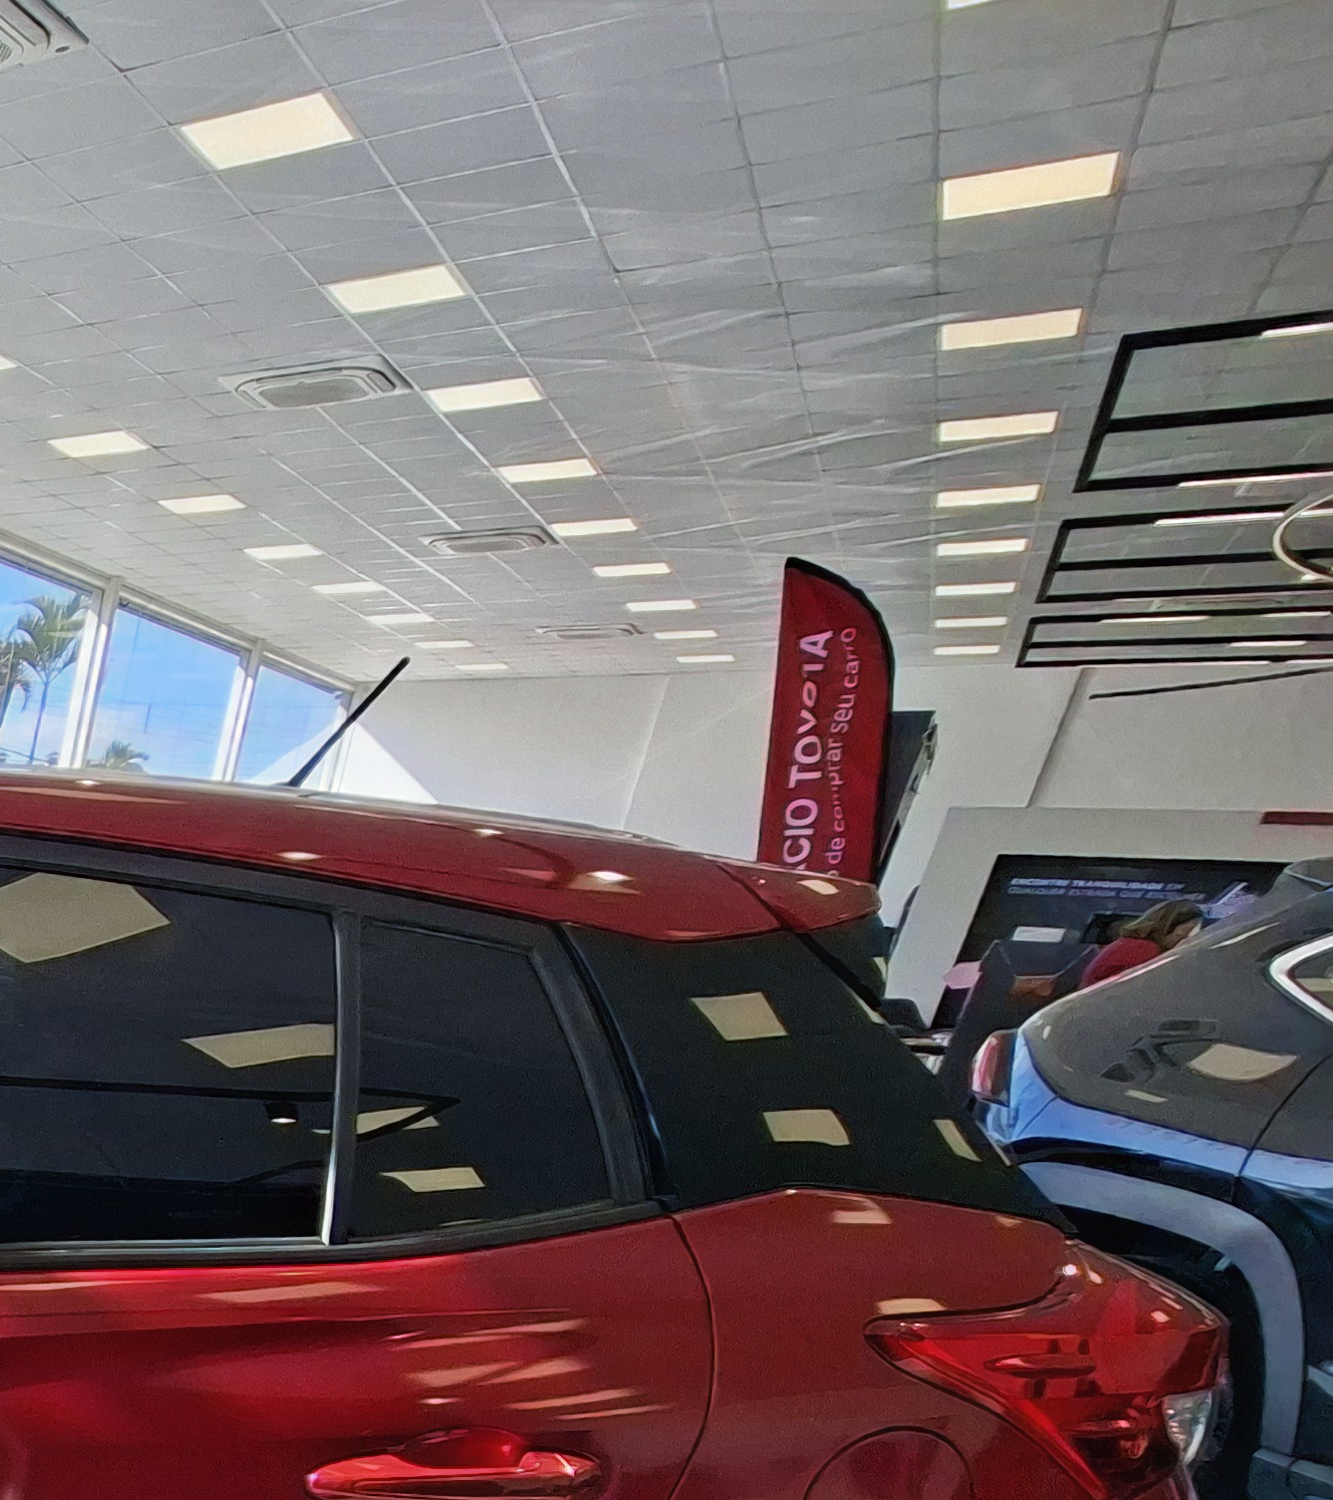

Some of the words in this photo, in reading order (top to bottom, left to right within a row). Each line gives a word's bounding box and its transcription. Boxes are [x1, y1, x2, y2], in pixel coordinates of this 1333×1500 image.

[839, 627, 860, 689] carro
[830, 692, 856, 734] seu
[783, 798, 819, 870] CIO
[825, 837, 846, 864] de
